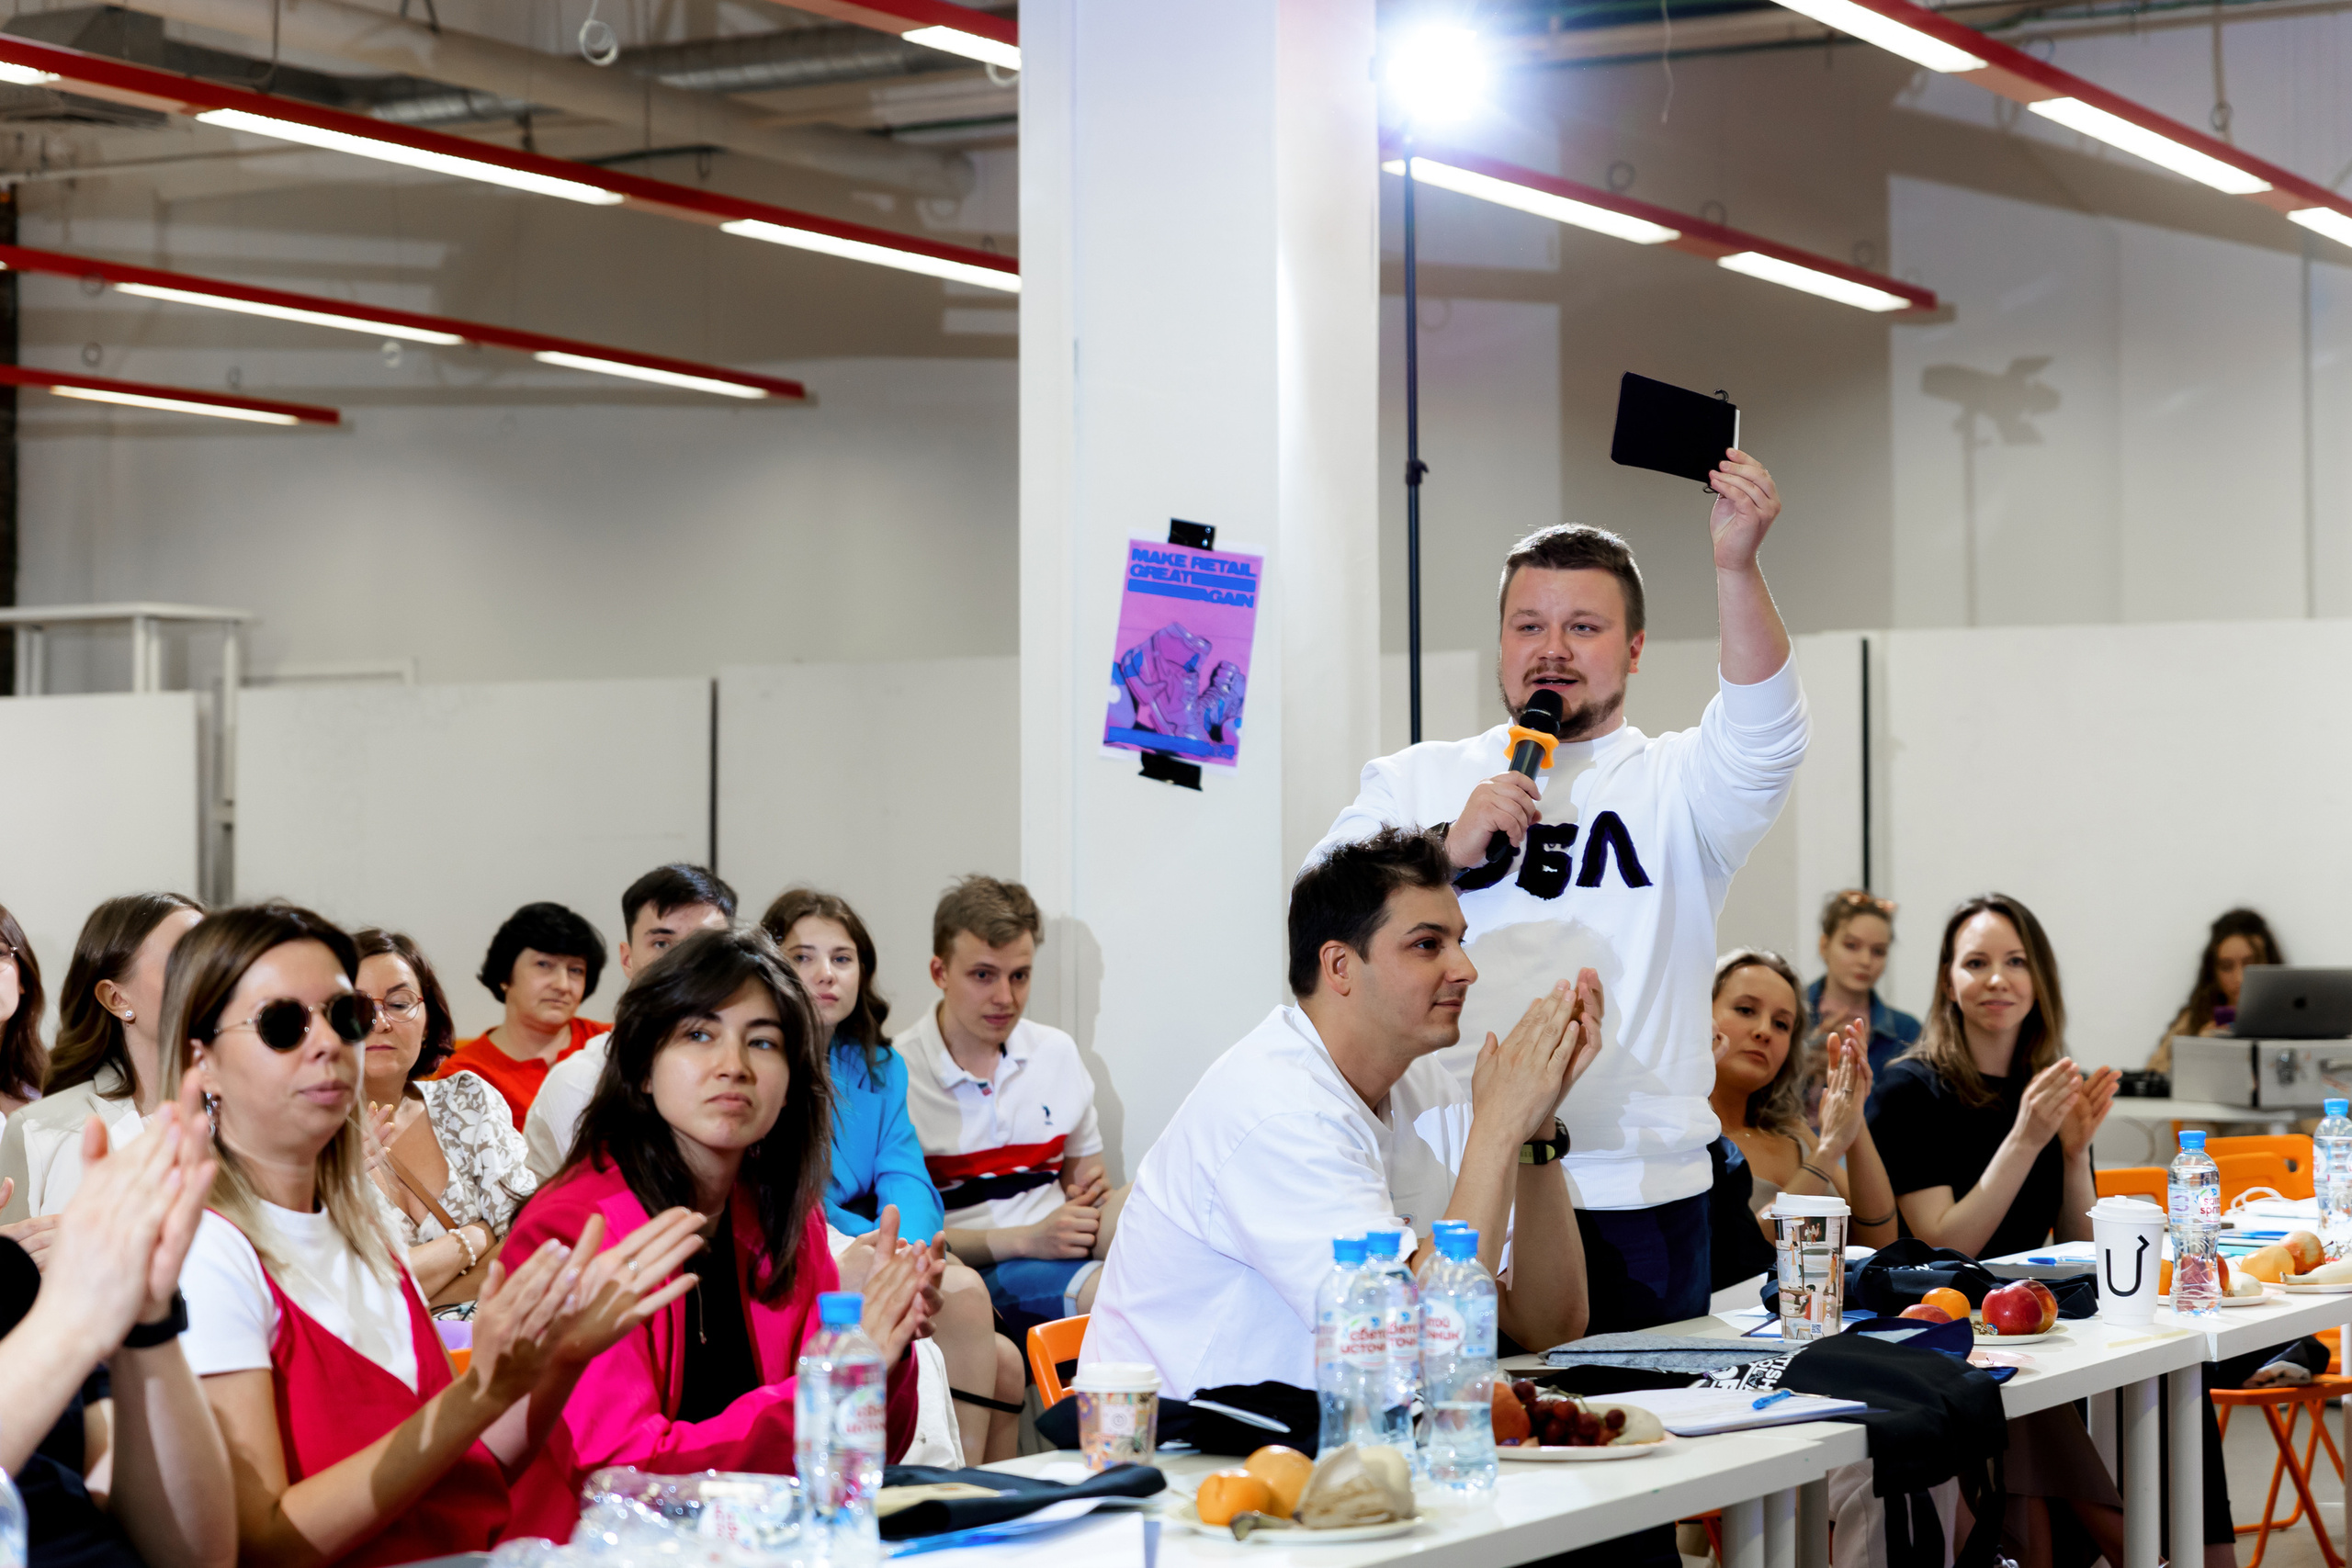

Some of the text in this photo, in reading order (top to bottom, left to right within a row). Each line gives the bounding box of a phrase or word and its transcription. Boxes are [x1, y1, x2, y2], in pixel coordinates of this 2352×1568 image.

[1131, 548, 1257, 577] MAKE RETAIL
[1752, 1359, 1774, 1376] OL
[1757, 1352, 1796, 1391] TISH
